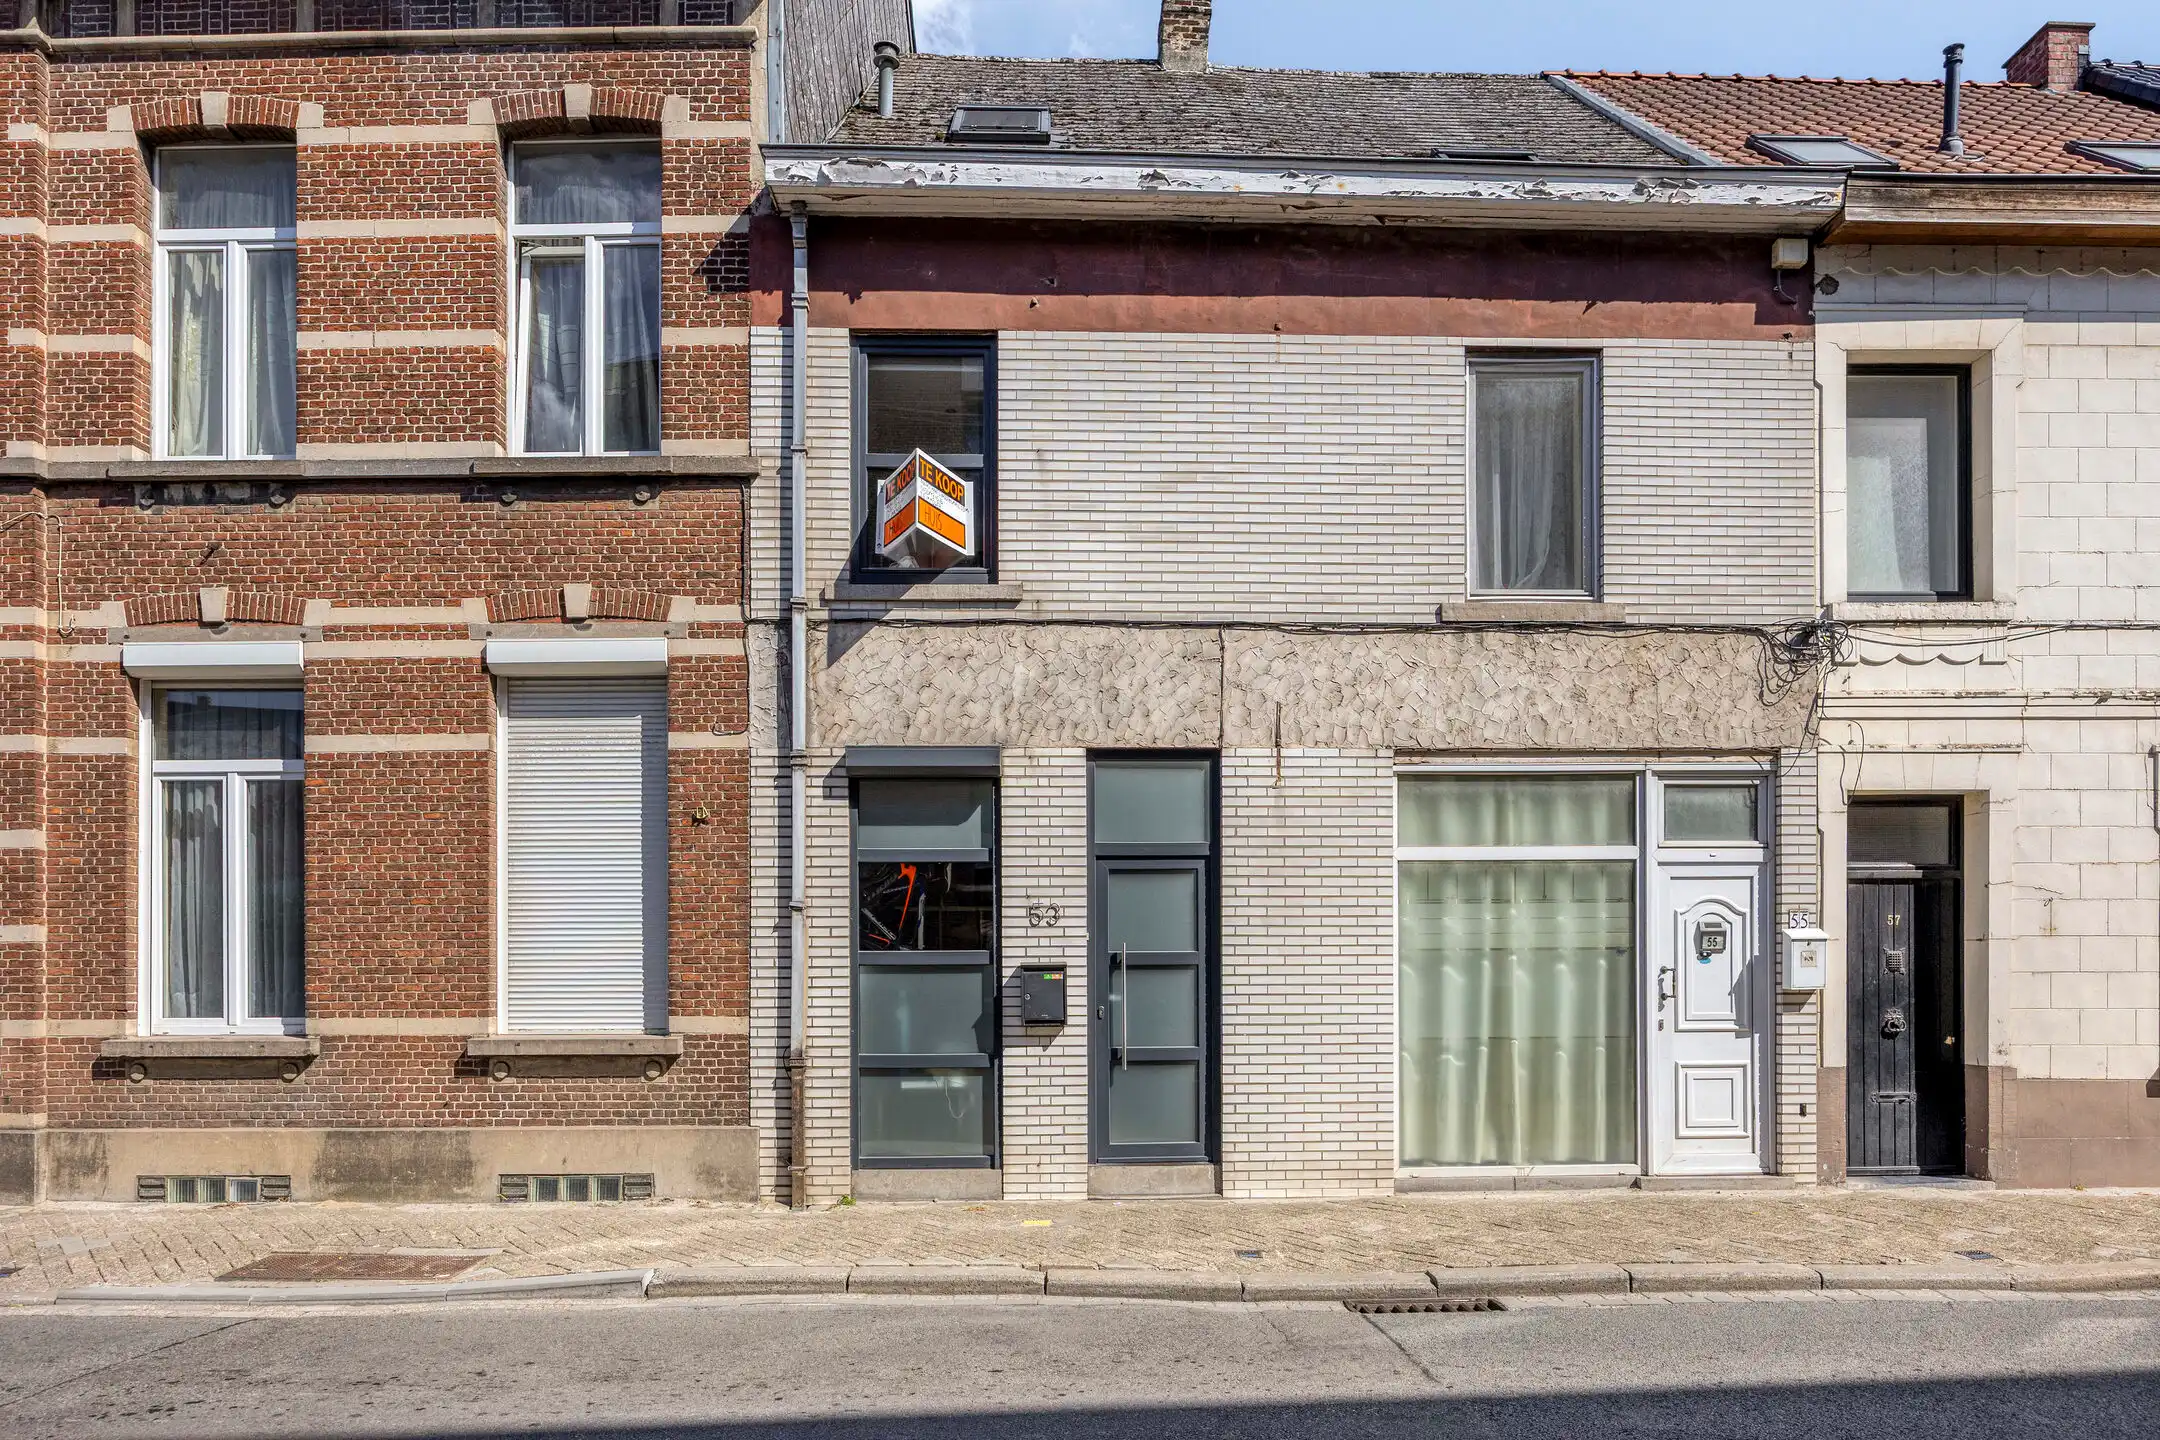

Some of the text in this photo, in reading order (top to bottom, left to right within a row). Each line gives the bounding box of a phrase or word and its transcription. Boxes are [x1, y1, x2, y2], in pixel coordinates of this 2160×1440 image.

[886, 480, 896, 501] TE
[897, 460, 916, 492] KOOP
[920, 457, 933, 483] TE
[935, 469, 964, 501] KOOP
[924, 505, 943, 531] HUIS
[1029, 902, 1060, 928] 53
[1790, 913, 1809, 929] 55
[1887, 914, 1901, 926] 57
[1707, 936, 1718, 948] 55
